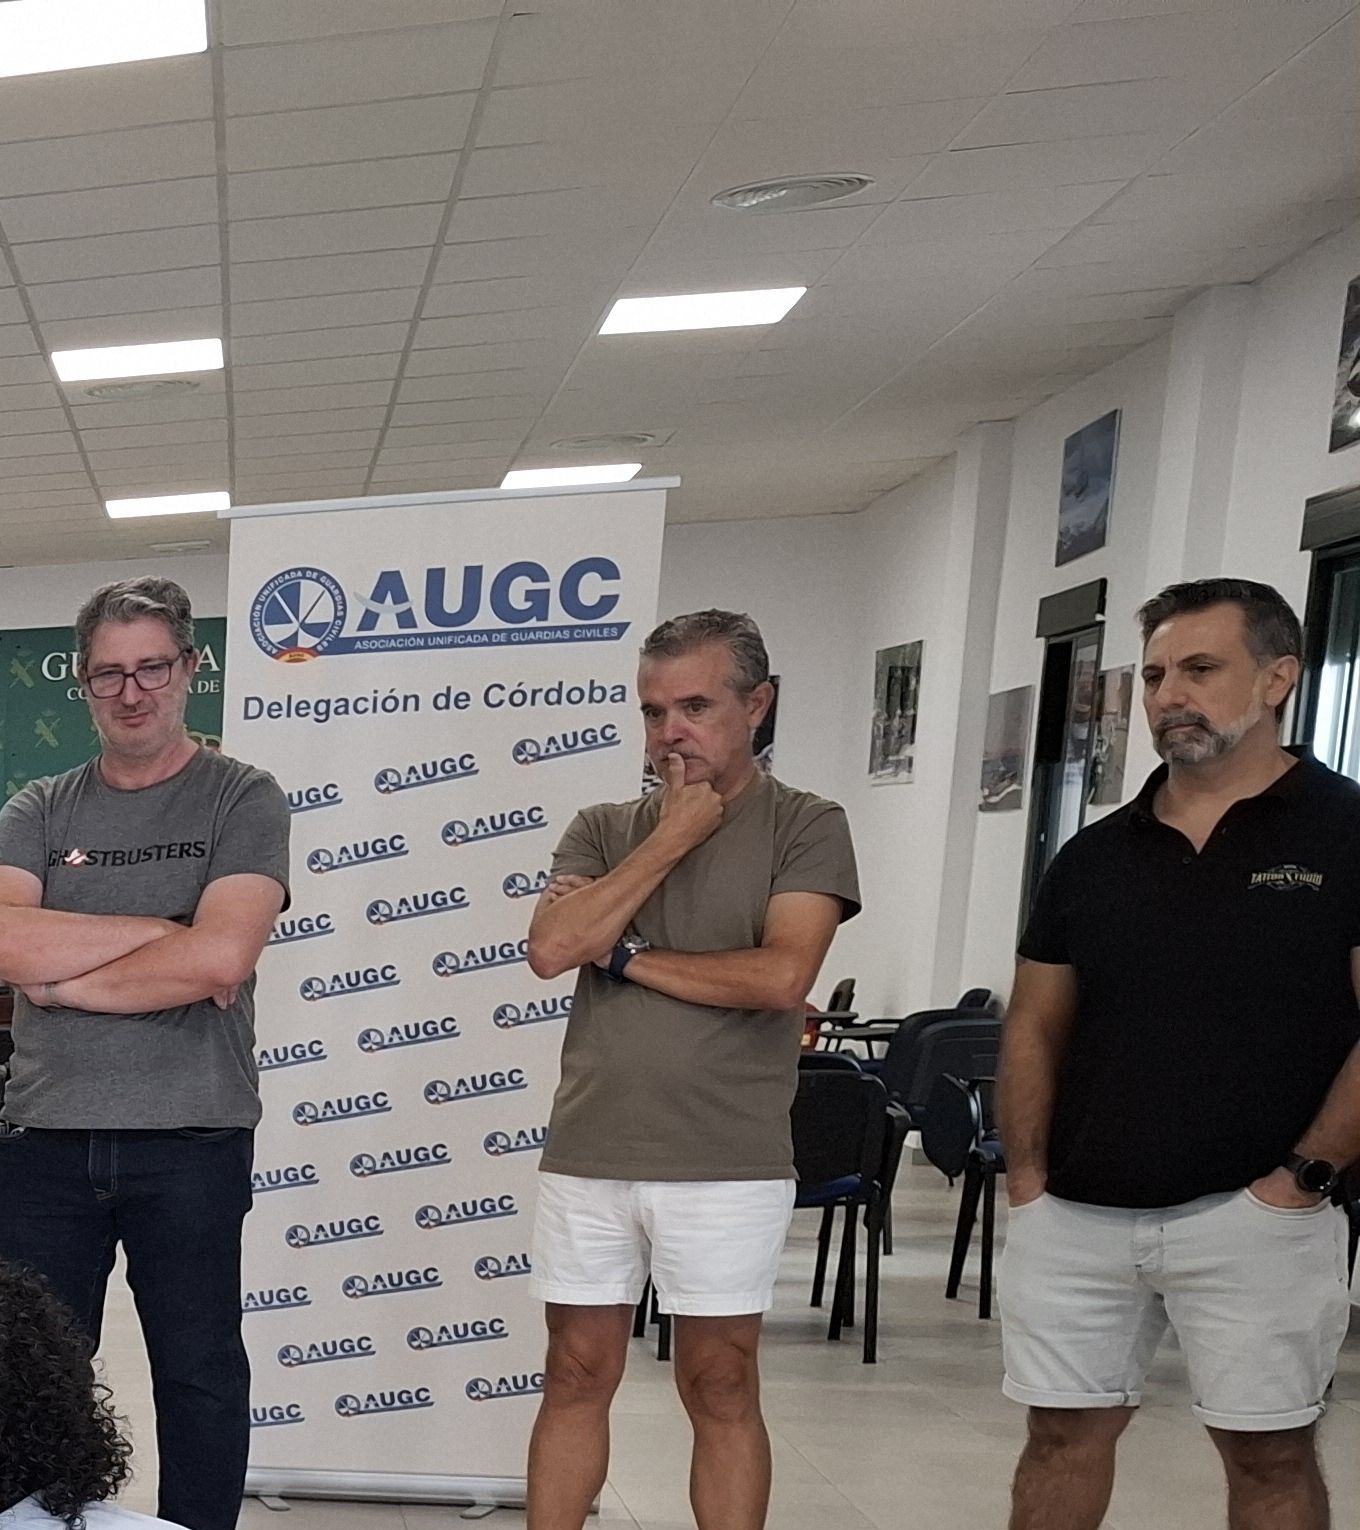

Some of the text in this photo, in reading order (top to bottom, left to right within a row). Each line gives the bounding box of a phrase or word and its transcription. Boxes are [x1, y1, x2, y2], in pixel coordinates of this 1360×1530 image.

[356, 556, 622, 632] AUGC
[354, 626, 619, 650] ASOCIACIÓN UNIFICADA DE GUARDIAS CIVILES
[197, 680, 220, 694] DE
[243, 679, 627, 723] Delegación de Córdoba
[544, 724, 618, 757] AUGC
[404, 753, 476, 783] AUGC
[288, 783, 340, 810] UGC
[472, 806, 545, 836] AUGC
[337, 834, 406, 864] AUGC
[395, 886, 467, 917] AUGC
[272, 913, 332, 940] UGC
[463, 939, 528, 968] AUG
[330, 964, 397, 992] AUGC
[525, 995, 574, 1018] AUG
[387, 1016, 458, 1044] AUGC
[258, 1039, 325, 1064] AUGC
[454, 1068, 525, 1095] AUGC
[321, 1091, 389, 1117] AUGC
[379, 1143, 448, 1168] AUGC
[252, 1164, 317, 1188] AUGC
[444, 1195, 515, 1218] AUGC
[312, 1215, 381, 1240] AUGC
[372, 1266, 440, 1290] AUGC
[245, 1286, 308, 1308] AUGC
[436, 1318, 505, 1342] AUGC
[306, 1336, 373, 1359] AUGC
[496, 1372, 544, 1395] AUG
[363, 1386, 431, 1409] AUGC
[252, 1404, 302, 1425] UGC
